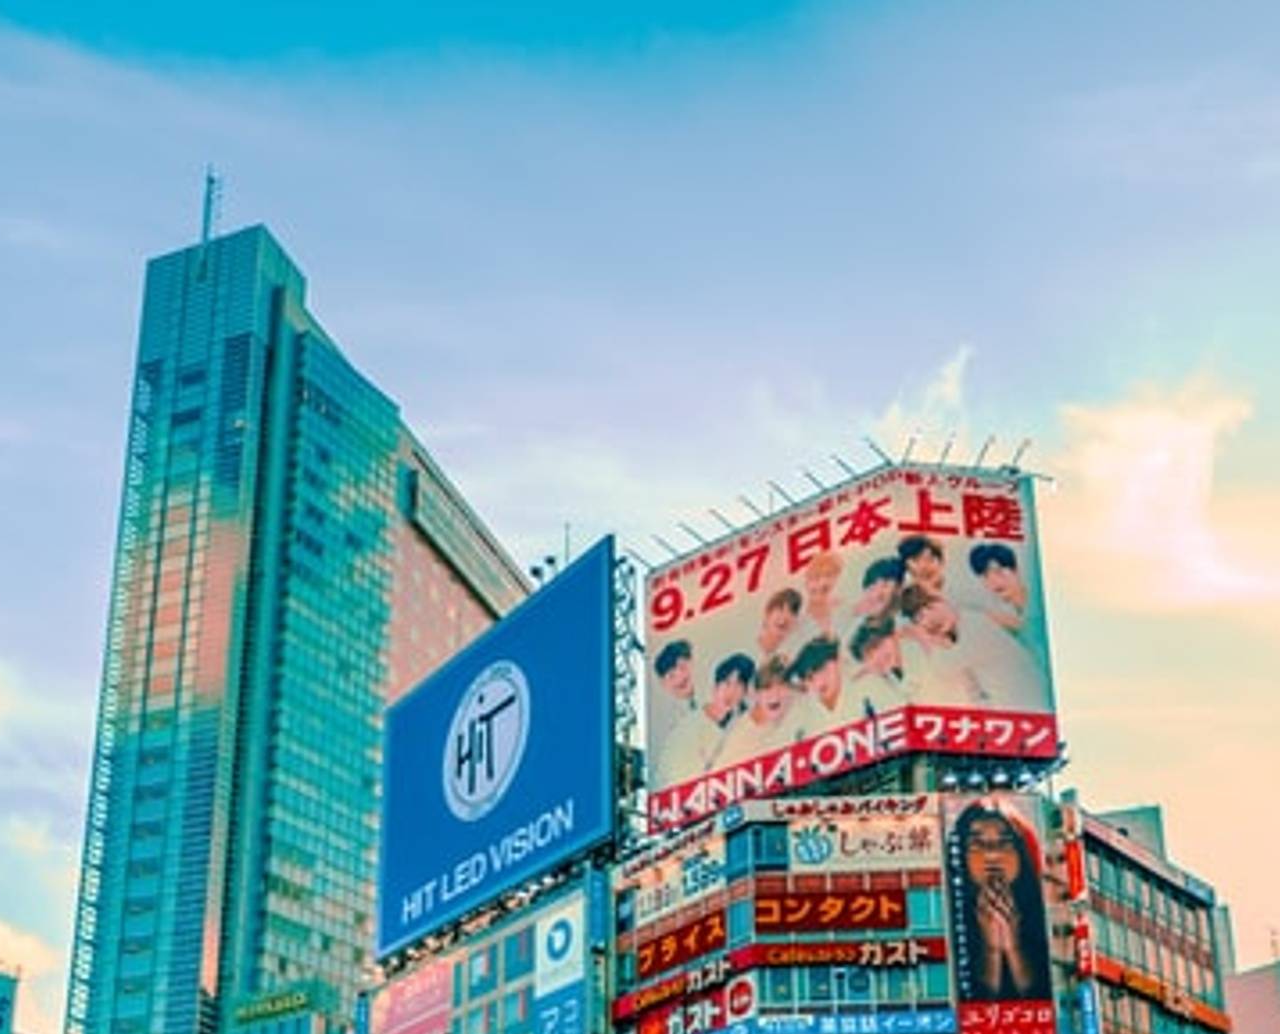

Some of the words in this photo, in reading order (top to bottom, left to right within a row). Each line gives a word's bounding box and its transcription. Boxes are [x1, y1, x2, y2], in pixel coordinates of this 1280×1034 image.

[651, 544, 770, 631] 9.27
[787, 488, 1025, 574] 日本上陸
[914, 713, 1052, 749] ワナワン
[400, 878, 439, 925] HIT
[439, 854, 487, 902] LED
[489, 797, 576, 872] VISION
[756, 896, 902, 923] コンタクト
